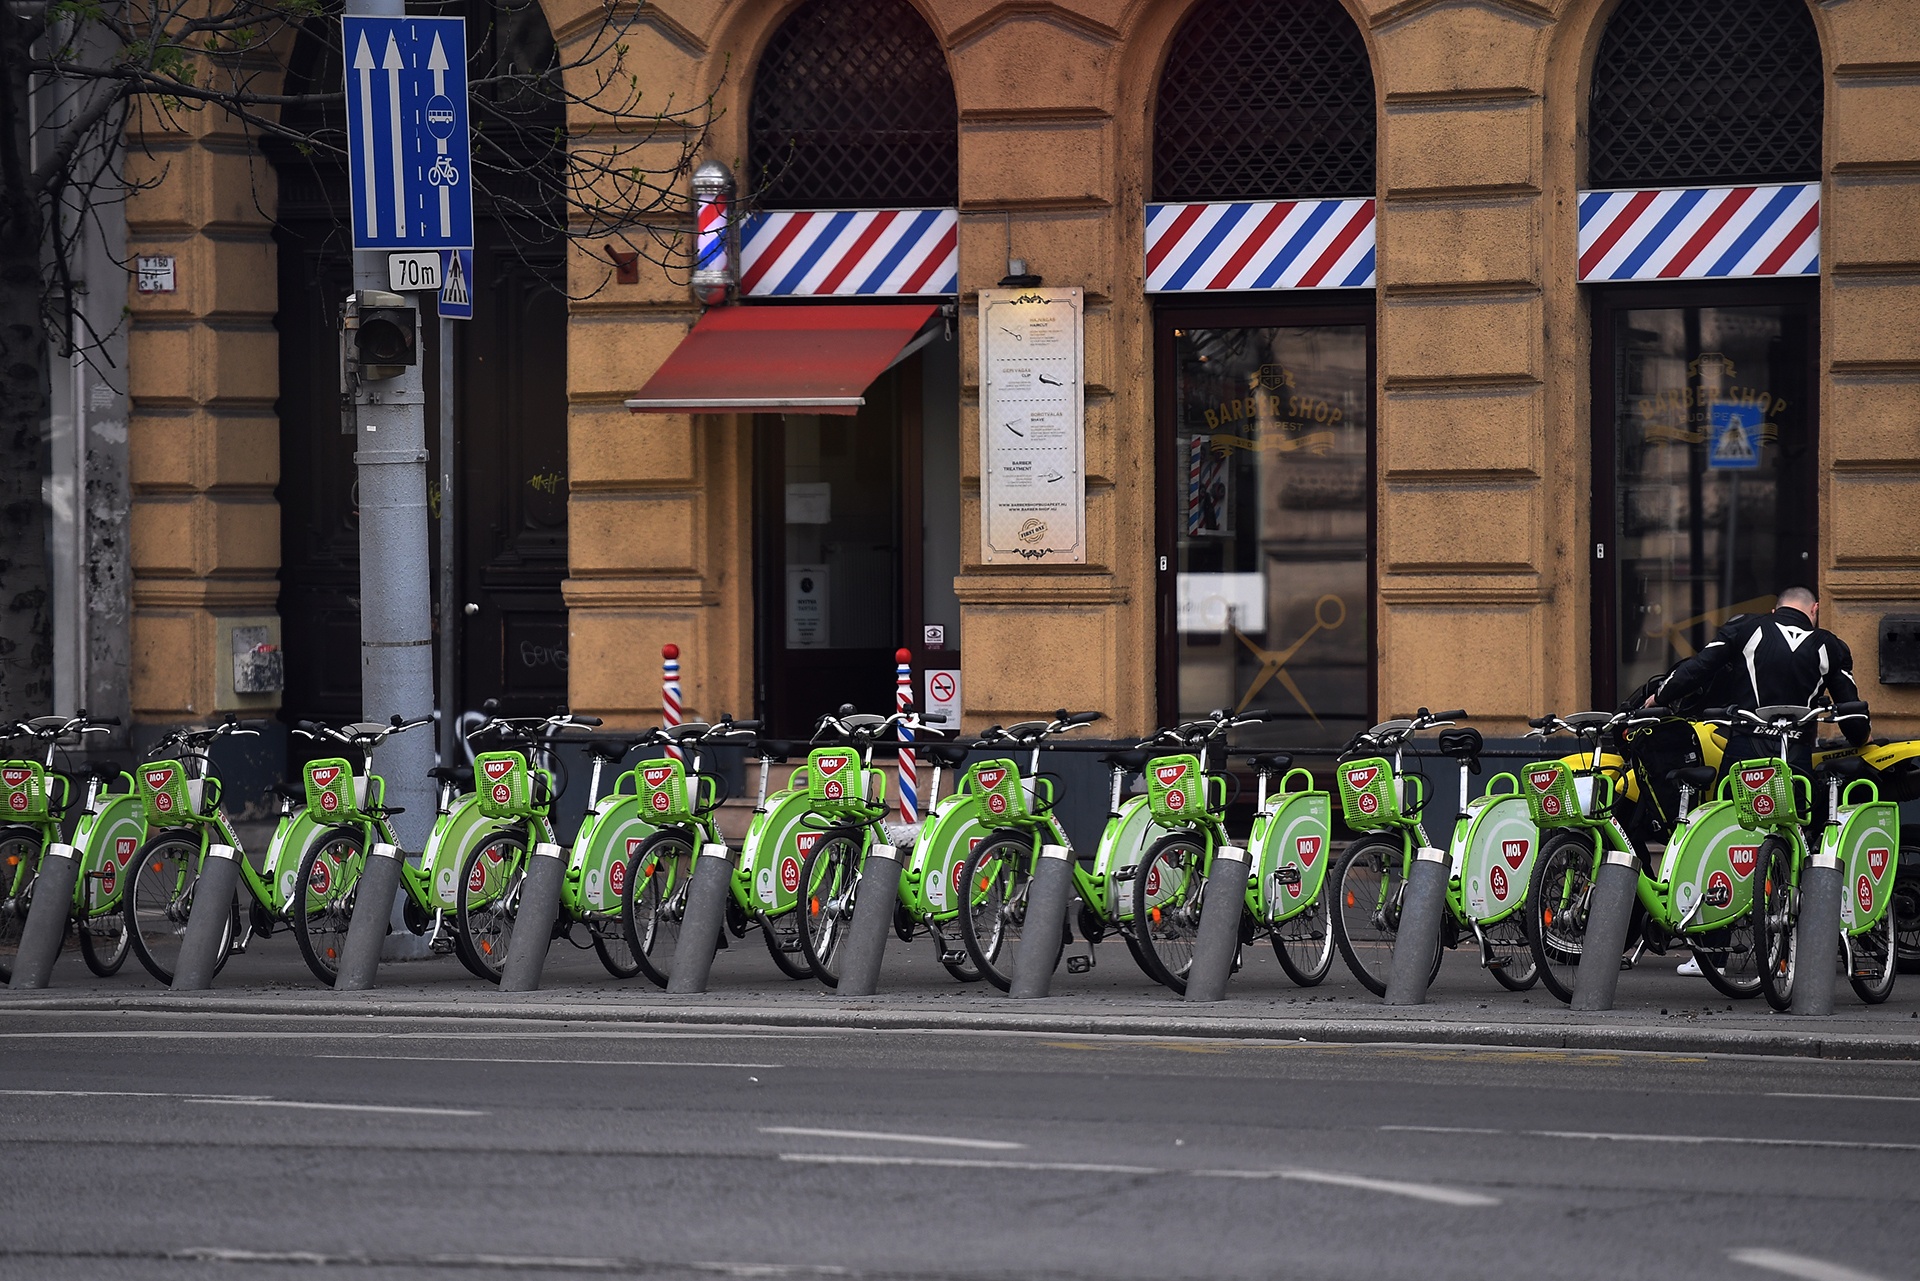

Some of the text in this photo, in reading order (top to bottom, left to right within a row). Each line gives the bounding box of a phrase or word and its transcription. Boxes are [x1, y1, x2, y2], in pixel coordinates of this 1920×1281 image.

[1638, 385, 1787, 420] BARBER SHOP
[1204, 395, 1343, 430] BARBER SHOP
[1678, 412, 1745, 424] BUDAPEST
[1242, 421, 1304, 433] BUDAPEST
[1020, 525, 1045, 539] FIRST ONE
[1821, 749, 1859, 762] SUZUKI
[1875, 754, 1895, 764] 400
[488, 764, 504, 772] MOL
[821, 759, 838, 768] MOL
[6, 771, 22, 780] MOL
[150, 772, 164, 782] MOL
[316, 770, 331, 780] MOL
[648, 770, 664, 780] MOL
[982, 772, 998, 782] MOL
[1160, 768, 1177, 778] MOL
[1351, 772, 1368, 782] MOL
[1534, 773, 1550, 783] MOL
[1746, 772, 1764, 782] MOL
[118, 842, 130, 854] MOL
[630, 842, 642, 852] MO
[1300, 840, 1314, 854] MOL
[1506, 844, 1521, 857] MOL
[1734, 850, 1754, 864] MOL
[1870, 856, 1883, 867] MOL
[785, 879, 796, 887] bubi
[1289, 884, 1300, 892] bubi
[1495, 886, 1506, 895] bubi
[1862, 898, 1870, 906] bubi
